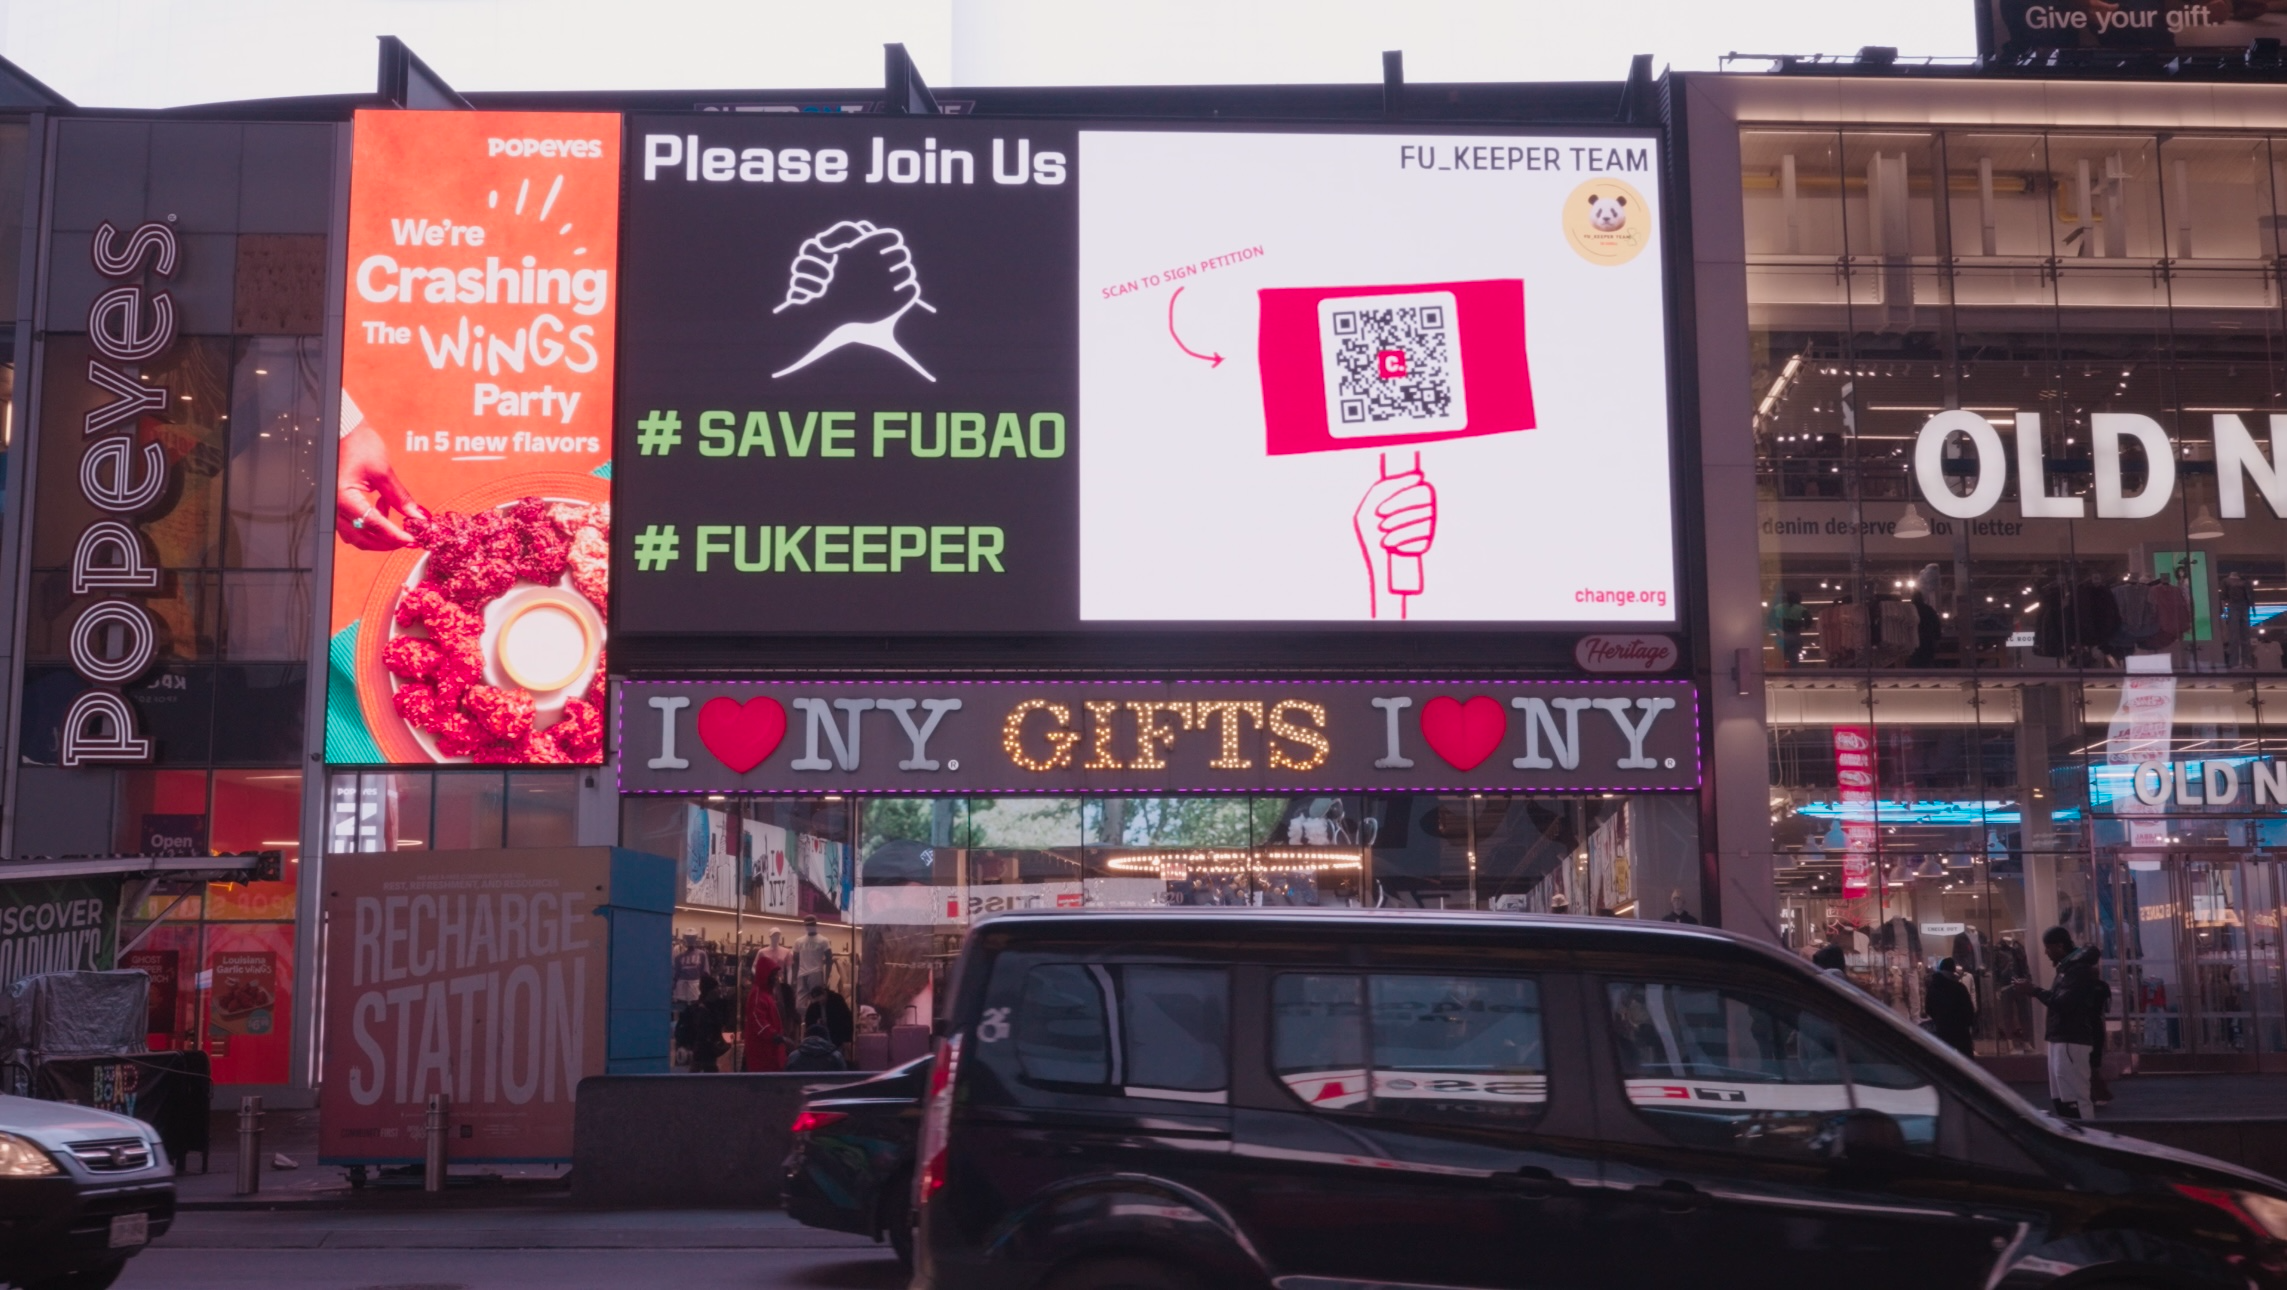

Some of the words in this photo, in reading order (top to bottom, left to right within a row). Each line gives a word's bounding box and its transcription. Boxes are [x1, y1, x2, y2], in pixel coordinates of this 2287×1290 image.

[2025, 5, 2088, 30] Give
[2096, 9, 2158, 34] your
[2165, 5, 2218, 33] gift.
[644, 134, 849, 183] Please
[865, 136, 975, 184] Join
[992, 138, 1067, 185] Us
[1400, 145, 1562, 171] FU_KEEPER
[1569, 147, 1650, 173] TEAM
[356, 254, 608, 315] Crashing
[1101, 281, 1139, 300] SCAN
[1141, 275, 1161, 289] TO
[1163, 265, 1197, 284] SIGN
[1199, 244, 1266, 276] PETITION
[362, 321, 411, 345] The
[474, 383, 581, 424] Party
[406, 432, 428, 453] in
[436, 432, 450, 453] 5
[454, 436, 506, 453] new
[512, 431, 600, 454] flavors
[698, 410, 856, 458] SAVE
[872, 411, 1065, 459] FUBAO
[1915, 409, 2176, 519] OLD
[1762, 517, 1820, 536] denim
[1972, 518, 2023, 537] letter
[696, 525, 1006, 573] FUKEEPER
[1574, 588, 1667, 606] change.org
[1586, 638, 1670, 667] Heritage
[648, 697, 690, 769] I
[1003, 698, 1330, 772] GIFTS
[1371, 696, 1415, 769] I
[2135, 760, 2239, 806] OLD
[151, 834, 193, 850] Open
[481, 879, 502, 889] AND
[353, 891, 589, 987] RECHARGE
[131, 955, 162, 964] GHOST
[217, 965, 243, 974] Garlic
[222, 956, 266, 965] Louisiana
[349, 956, 584, 1106] STATION
